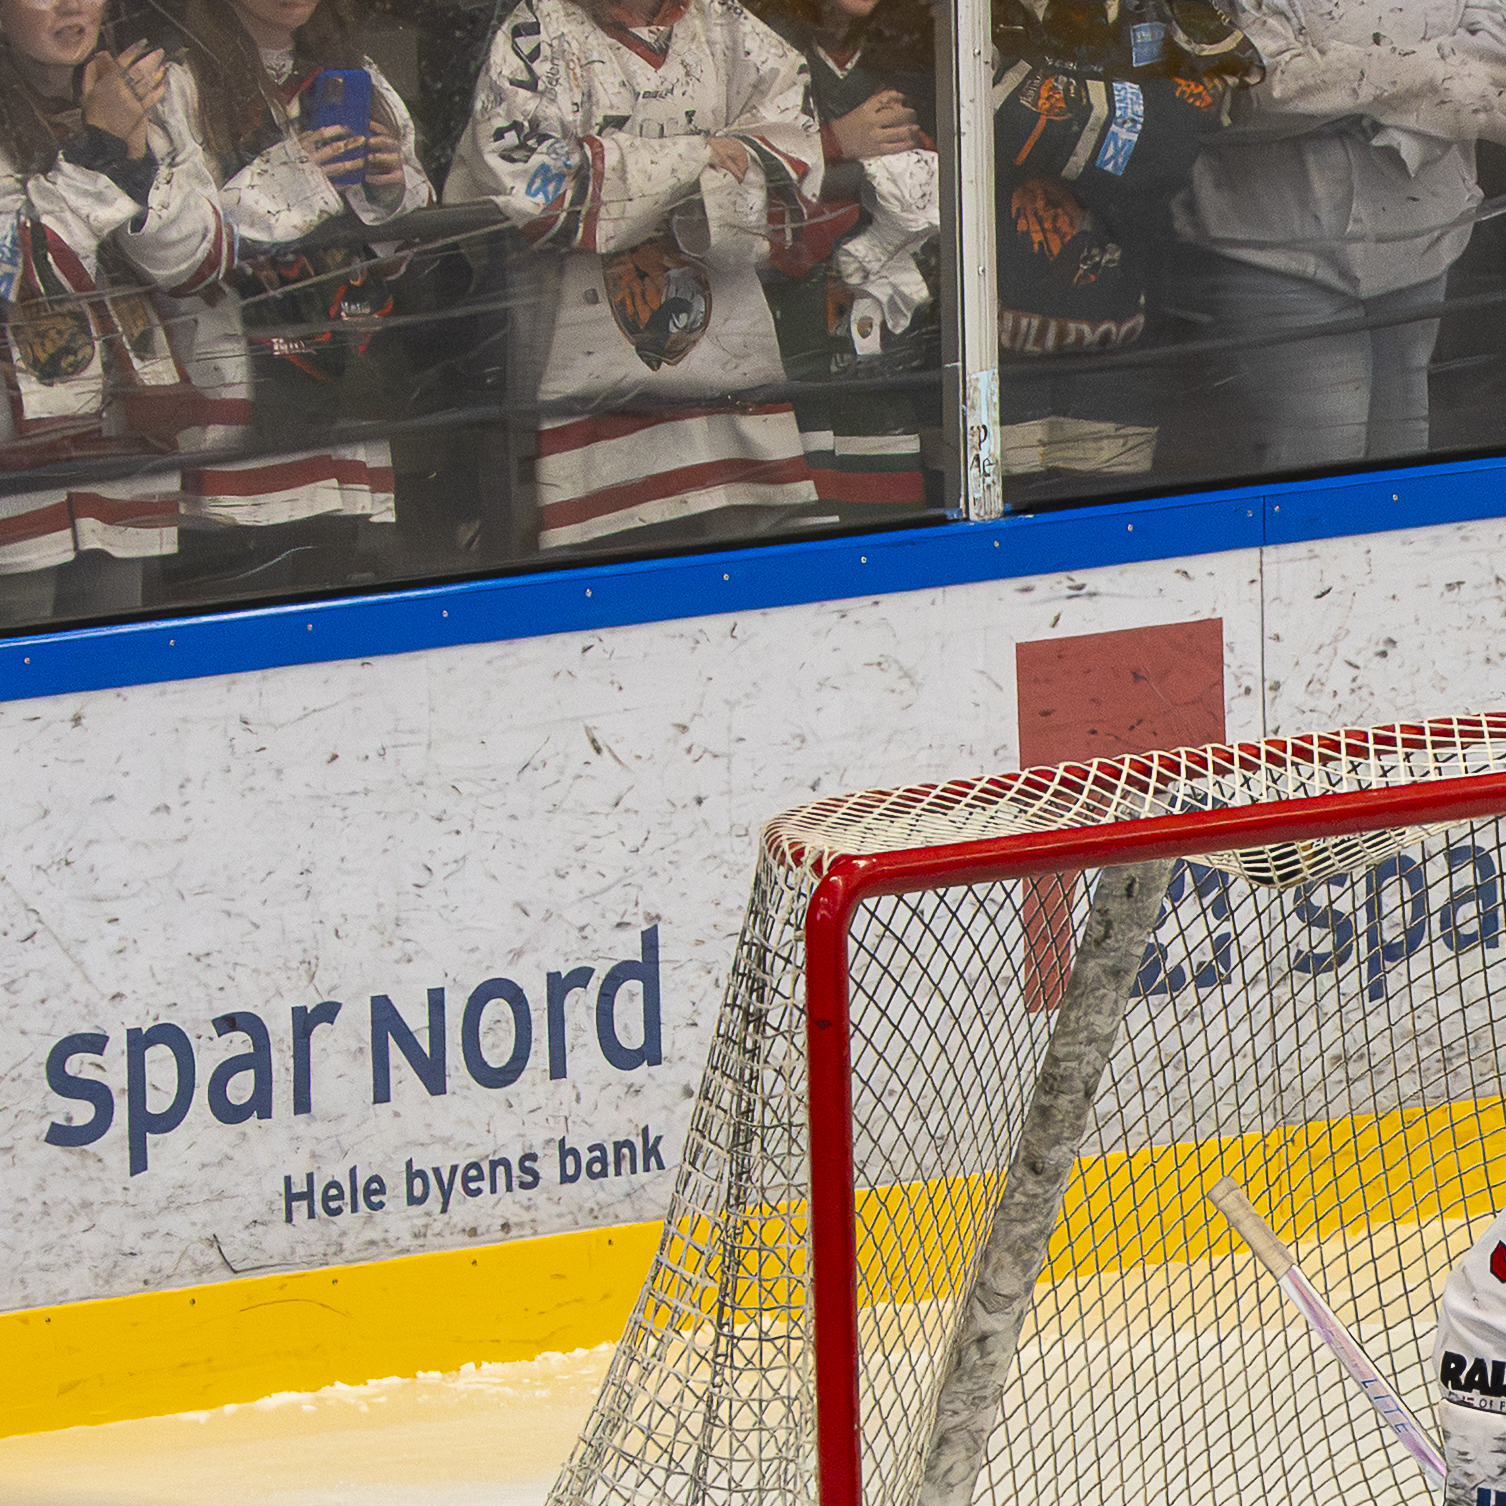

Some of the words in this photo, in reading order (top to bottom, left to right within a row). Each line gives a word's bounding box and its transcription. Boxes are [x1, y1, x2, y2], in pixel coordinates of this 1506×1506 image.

[44, 999, 343, 1177] spar
[284, 1164, 388, 1224] Hele
[404, 1149, 542, 1215] byens
[558, 1123, 668, 1186] bank
